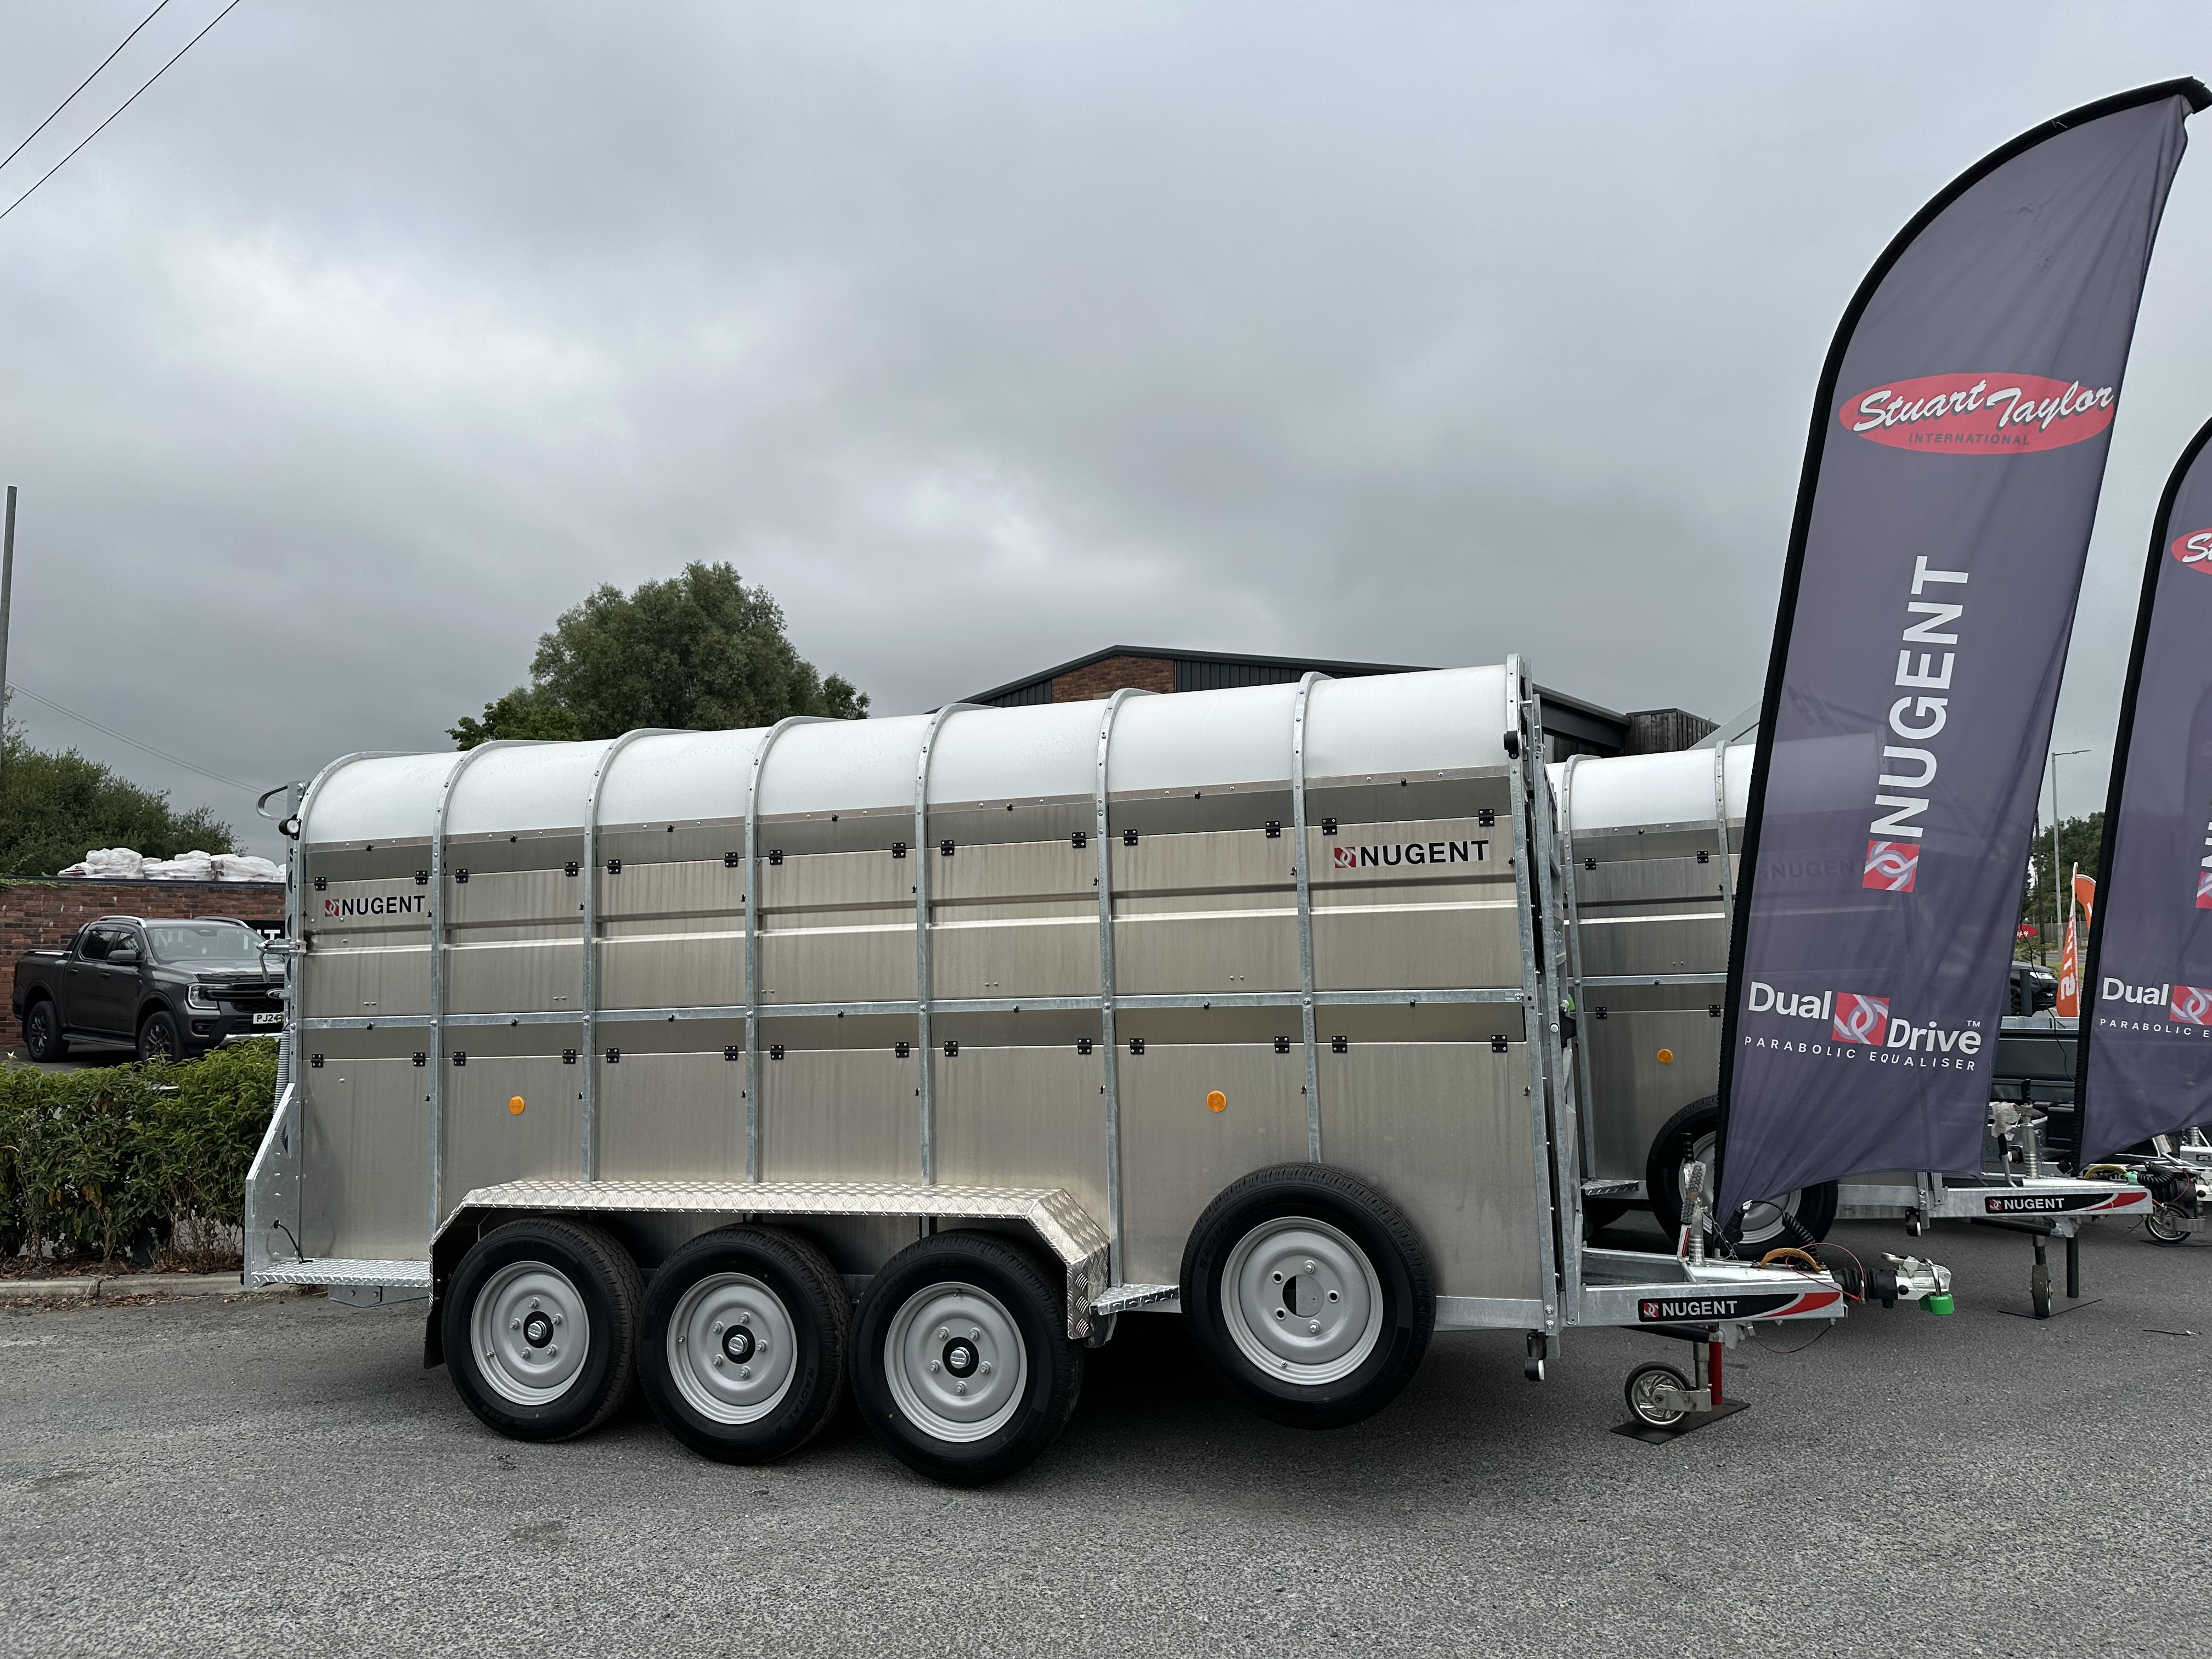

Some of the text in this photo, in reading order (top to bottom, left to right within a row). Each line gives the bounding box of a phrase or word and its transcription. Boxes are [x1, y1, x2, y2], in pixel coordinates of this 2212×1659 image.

[1853, 379, 2114, 431] Stuart Taylor
[1909, 433, 2029, 445] INTERNATIONAL
[1870, 555, 1969, 838] NUGENT
[1359, 839, 1489, 867] NUGENT
[341, 895, 426, 916] NUGENT
[2102, 977, 2169, 1006] Dual
[1748, 981, 1832, 1020] Dual
[1886, 1018, 1982, 1055] Drive
[2100, 1018, 2192, 1036] PARABOLIC
[1744, 1036, 1976, 1071] PARABOLIC EQUALISER
[2004, 1198, 2065, 1210] NUGENT
[1662, 1300, 1738, 1317] NUGENT
